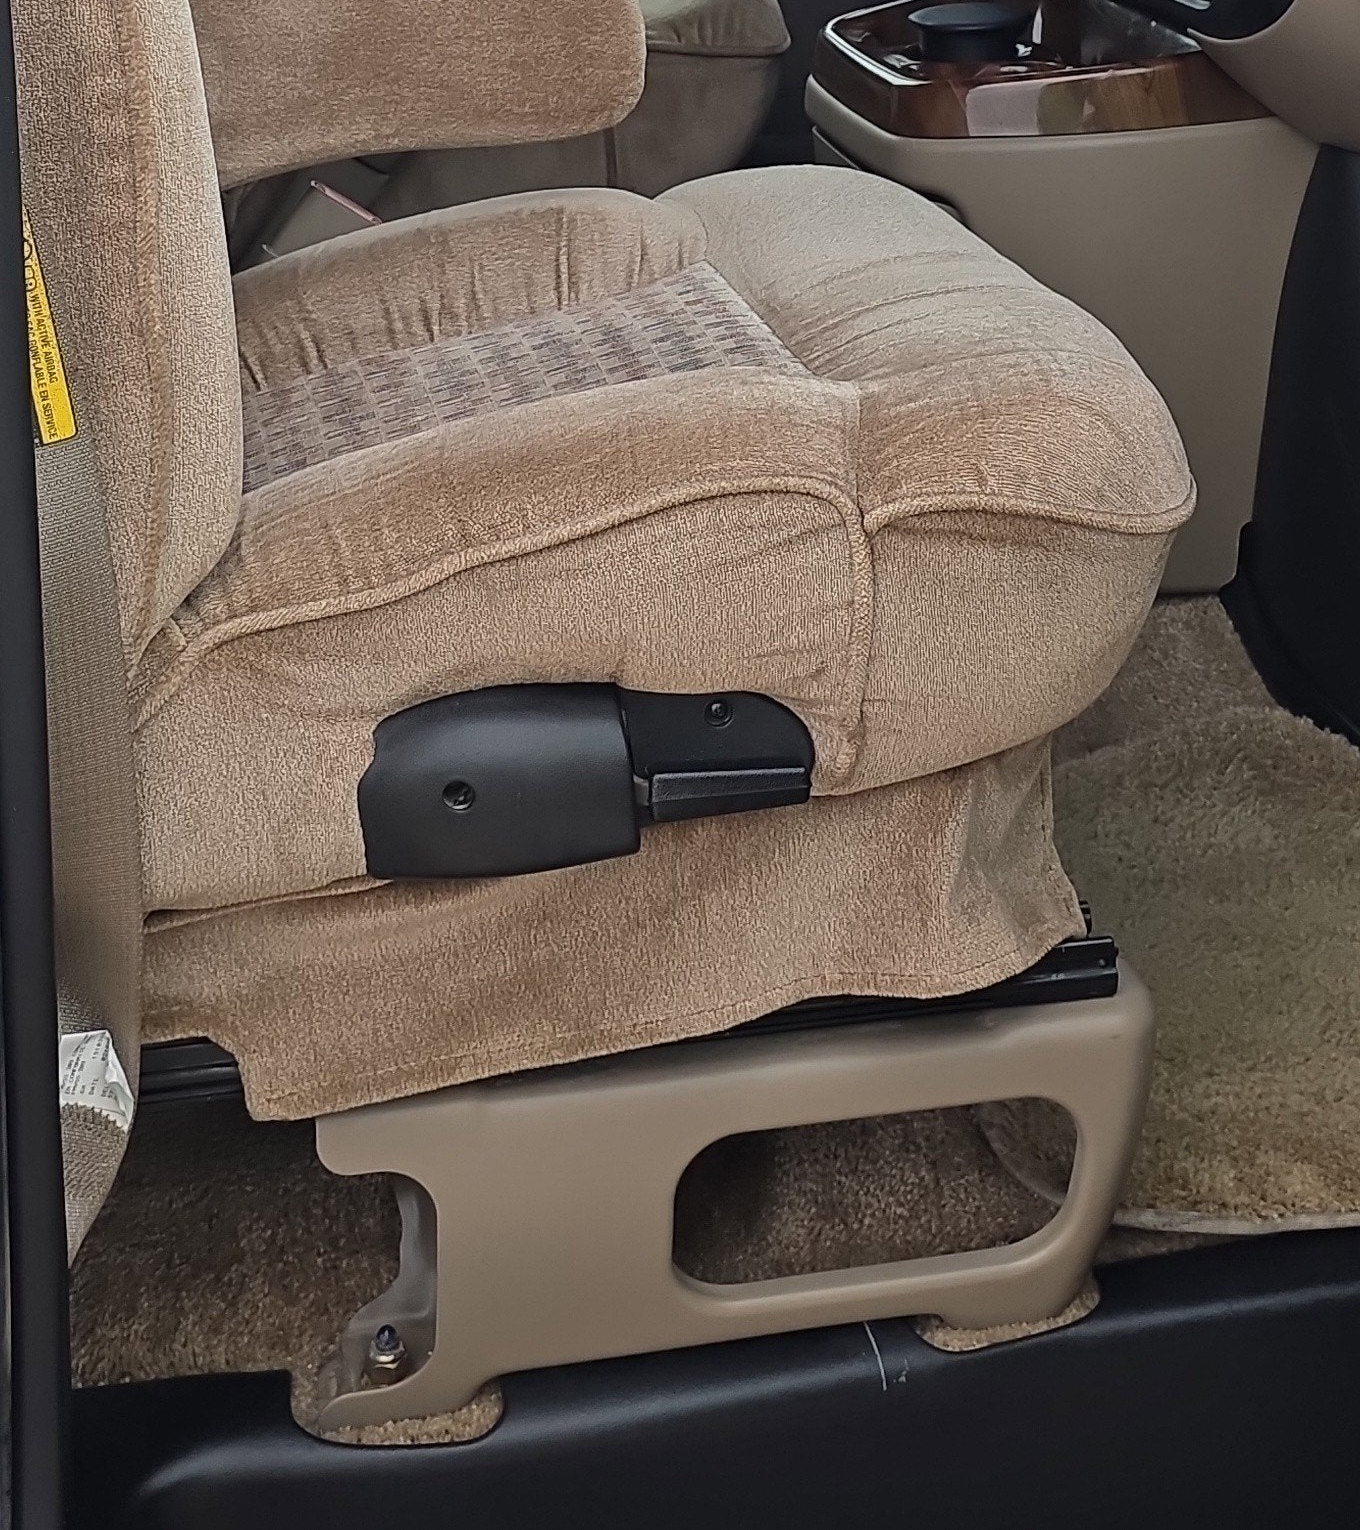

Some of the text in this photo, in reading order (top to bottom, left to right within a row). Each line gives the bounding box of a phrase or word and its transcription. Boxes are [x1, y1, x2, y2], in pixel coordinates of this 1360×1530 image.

[29, 292, 58, 384] WITH ACTIVE AIRBAG
[29, 339, 47, 389] GONFLABLE
[39, 390, 49, 402] EN
[42, 403, 58, 440] SERVICE
